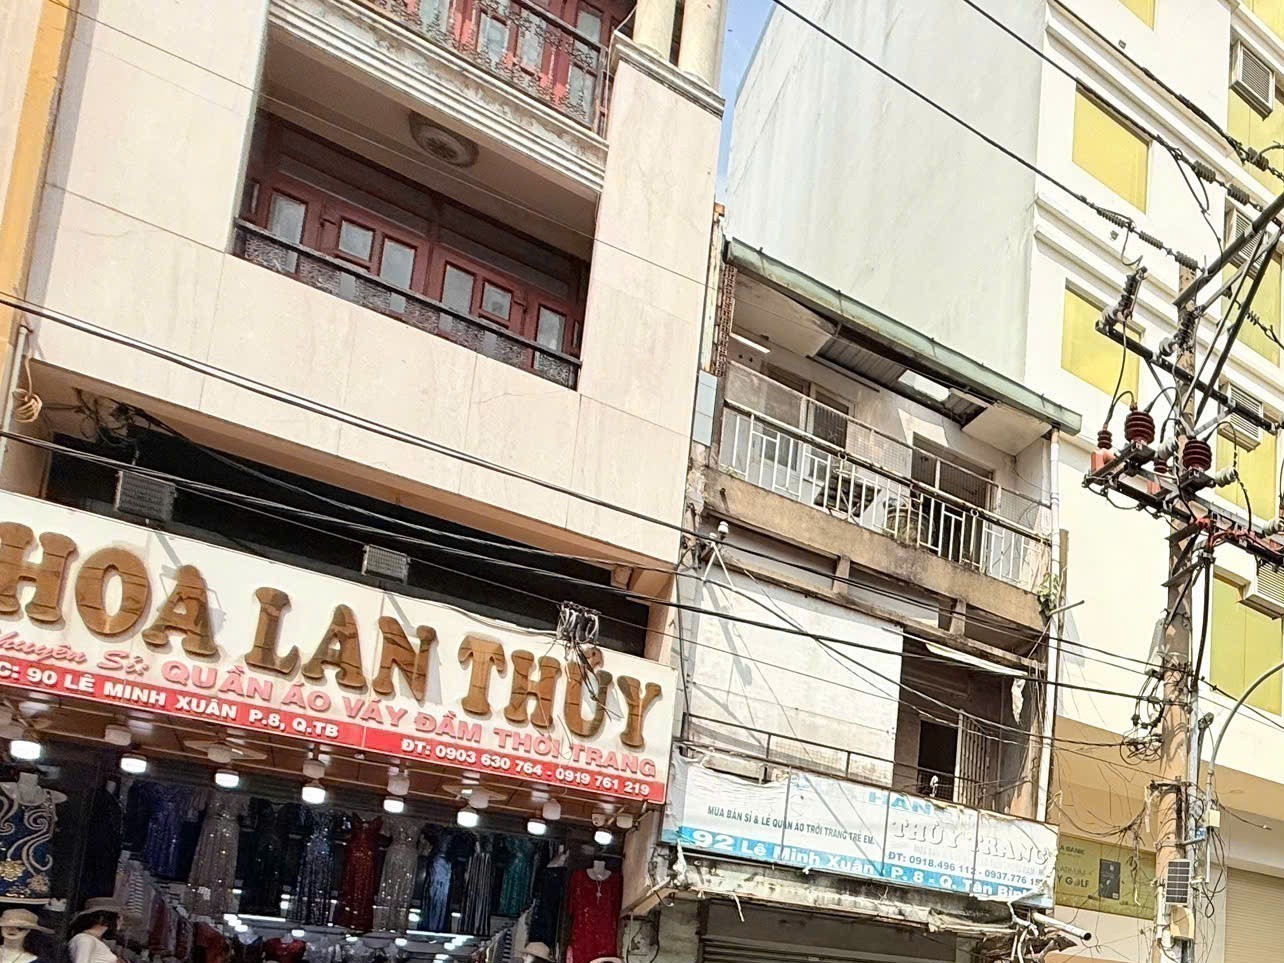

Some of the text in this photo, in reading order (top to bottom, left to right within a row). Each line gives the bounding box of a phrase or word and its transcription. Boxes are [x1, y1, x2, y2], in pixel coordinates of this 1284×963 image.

[0, 521, 218, 655] HOA
[244, 586, 439, 701] LAN
[0, 630, 87, 664] huyên
[161, 660, 274, 701] QUẦN
[281, 682, 331, 713] ÁO
[343, 695, 408, 727] VÁY
[494, 727, 560, 758] THỜI
[570, 743, 656, 777] TRANG
[27, 667, 57, 686] 90
[64, 674, 95, 693] LÊ
[104, 681, 167, 706] MINH
[176, 694, 237, 719] XUÂN
[292, 717, 339, 738] Q.TB
[402, 738, 431, 755] ĐT:
[436, 744, 476, 764] 0903
[481, 754, 510, 770] 630
[516, 761, 542, 776] 764
[556, 768, 591, 784] 0919
[595, 775, 619, 790] 761
[624, 781, 650, 796] 219
[707, 804, 725, 818] MUA
[753, 815, 759, 824] &
[693, 830, 734, 850] 92
[741, 839, 767, 857] Lê
[773, 844, 820, 866] Minh
[891, 866, 907, 880] P.
[913, 871, 924, 883] 8
[888, 851, 906, 862] ĐT:
[909, 855, 955, 871] 0918.496
[984, 869, 1027, 884] 0937.776
